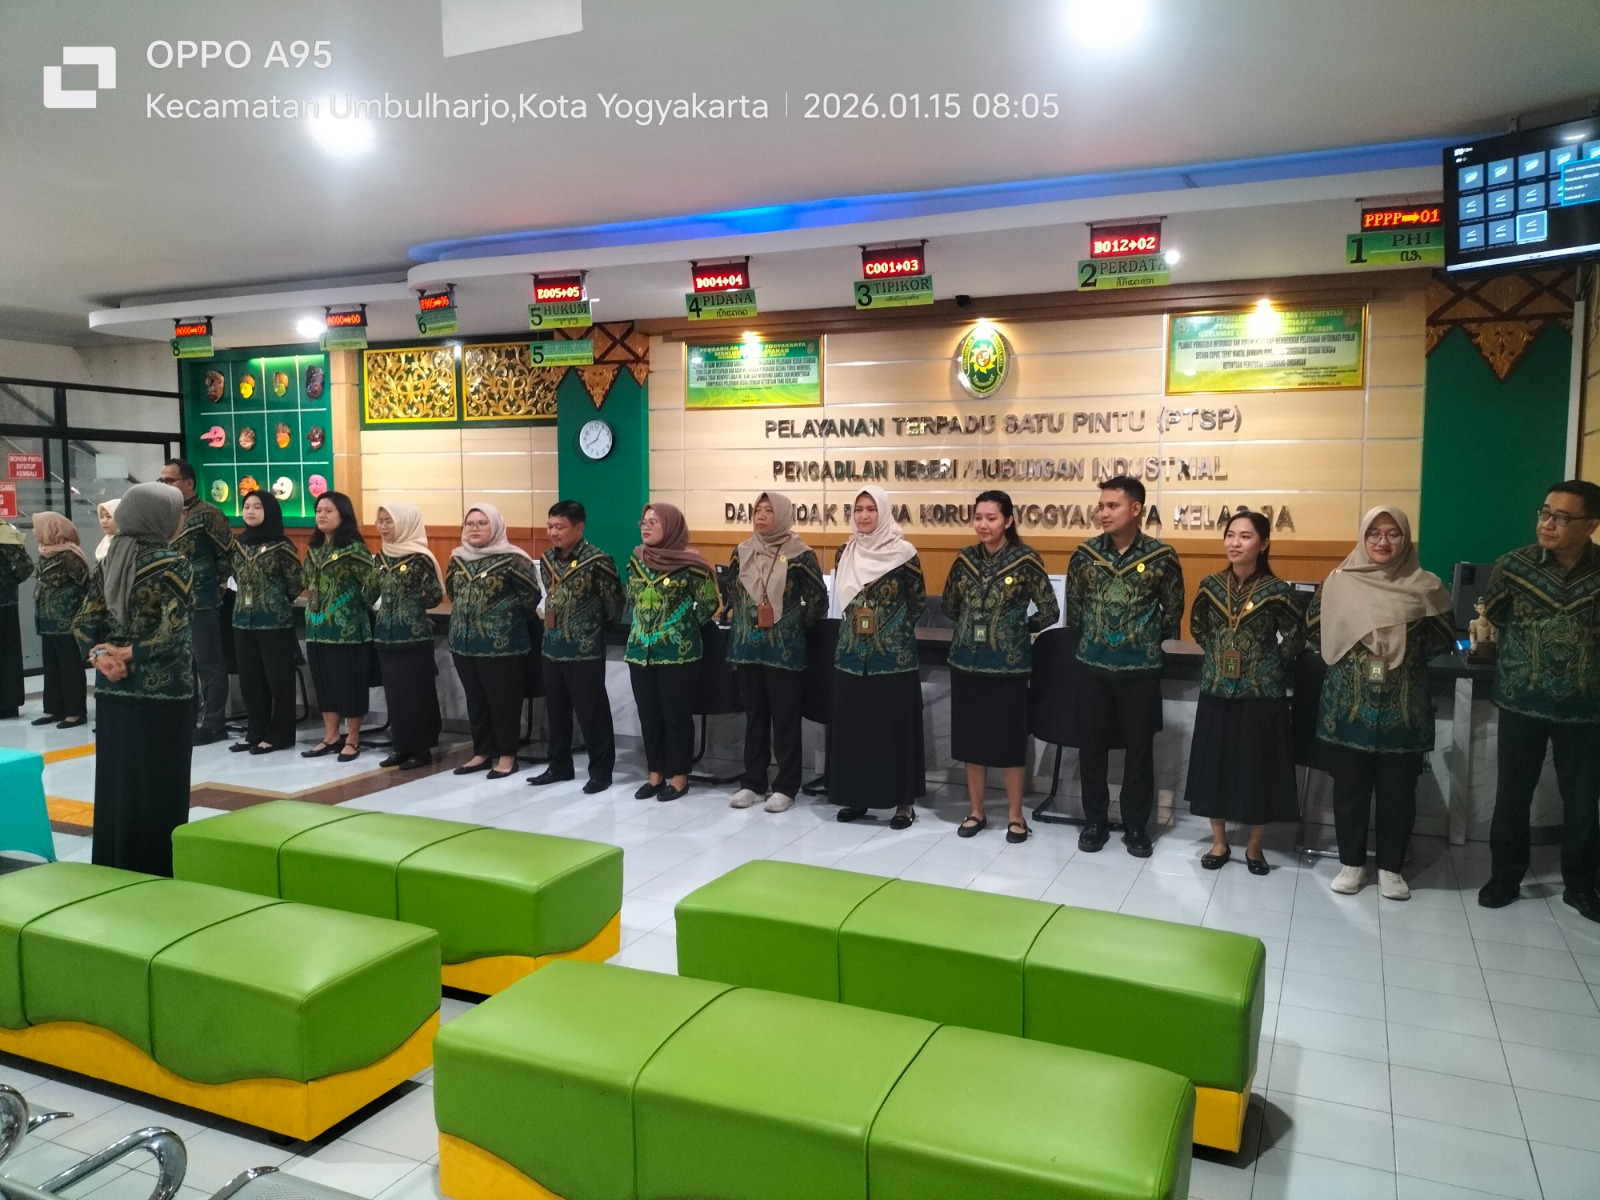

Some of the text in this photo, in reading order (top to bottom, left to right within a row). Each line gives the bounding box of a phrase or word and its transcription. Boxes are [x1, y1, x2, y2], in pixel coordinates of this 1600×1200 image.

[1350, 231, 1432, 264] 1 PHI
[865, 259, 919, 275] C001 03
[1080, 256, 1168, 288] 2 PERDATA
[688, 292, 753, 318] 4 PIDANA
[857, 283, 873, 307] 3
[873, 278, 930, 294] TIPIKOR
[418, 315, 427, 334] 6
[530, 306, 544, 327] 5
[543, 303, 588, 316] HUKUM
[172, 340, 180, 357] 8
[532, 345, 545, 364] 5
[765, 405, 1242, 438] PELAYANAN TERPADU SATU PINTU (PTSP)
[773, 460, 888, 482] PENGADILAN
[894, 458, 958, 481] NEGERI
[1091, 456, 1229, 482] INDUSTRIAL
